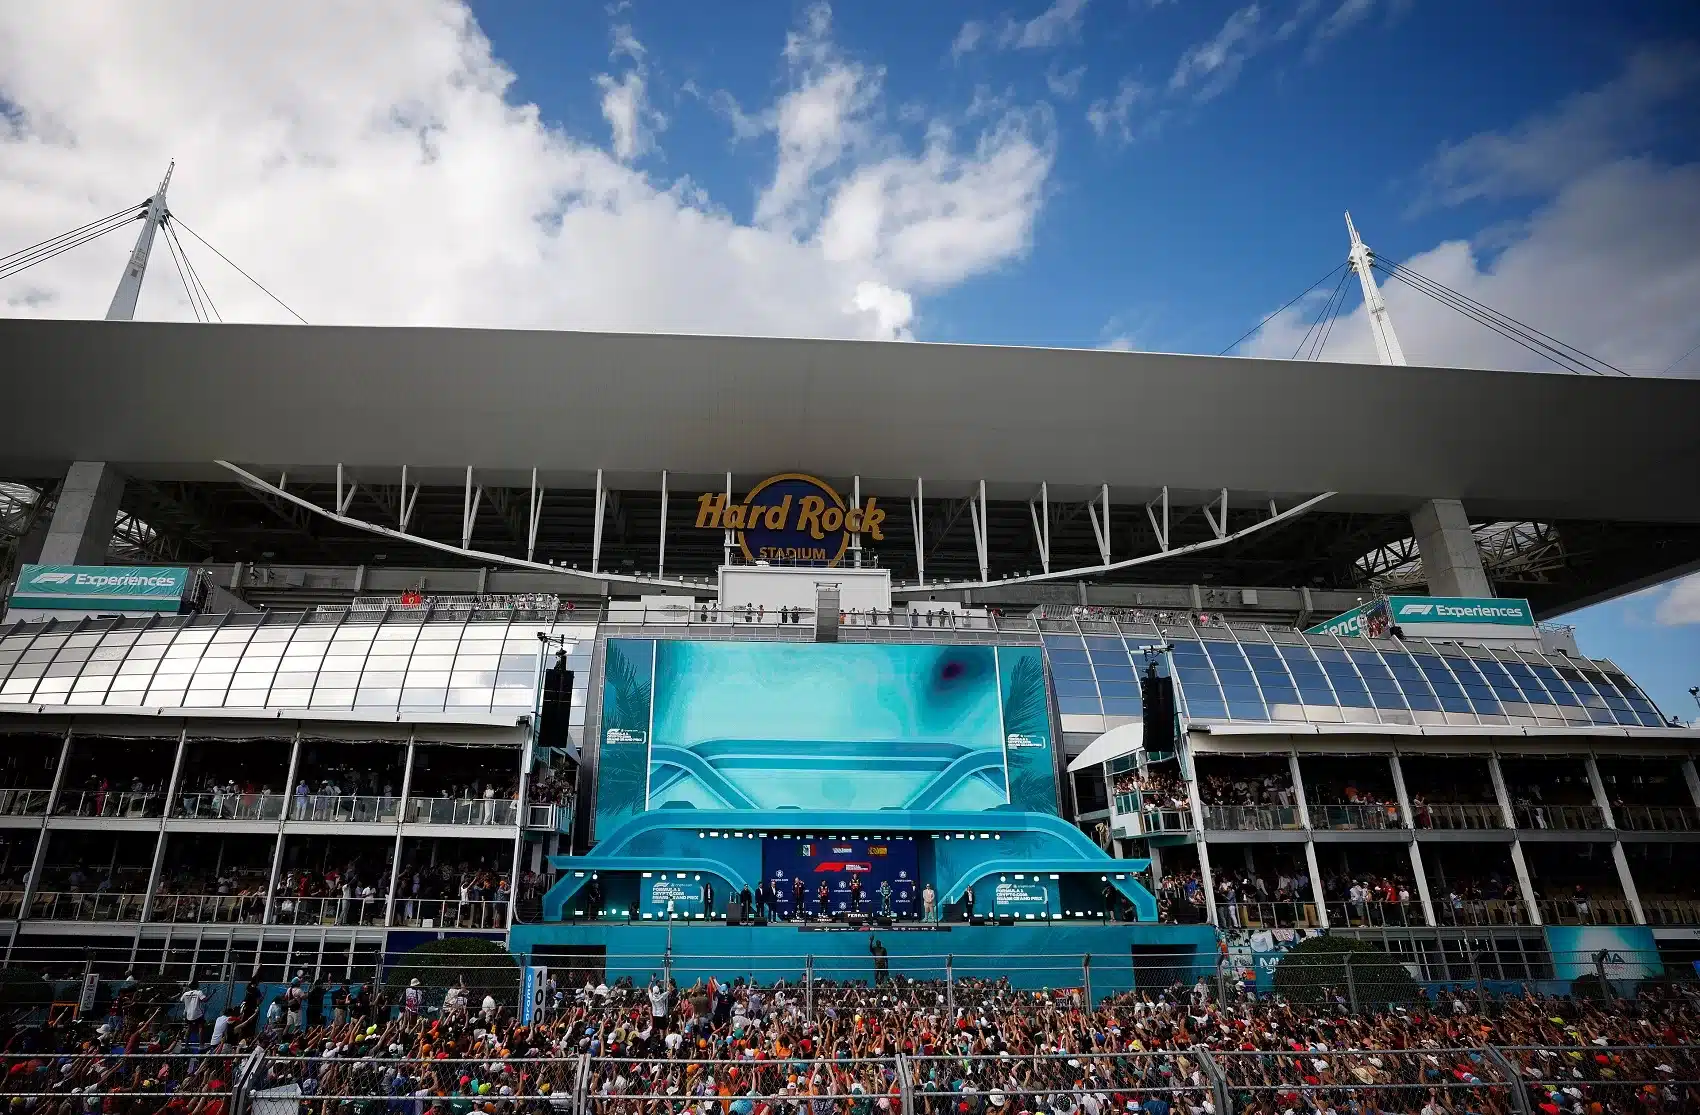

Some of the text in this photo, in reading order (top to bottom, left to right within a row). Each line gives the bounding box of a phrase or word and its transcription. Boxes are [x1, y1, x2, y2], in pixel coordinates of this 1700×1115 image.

[695, 492, 886, 541] Hard Rock
[759, 546, 826, 560] STADIUM
[75, 573, 176, 587] Experiences
[1436, 604, 1523, 618] Experiences
